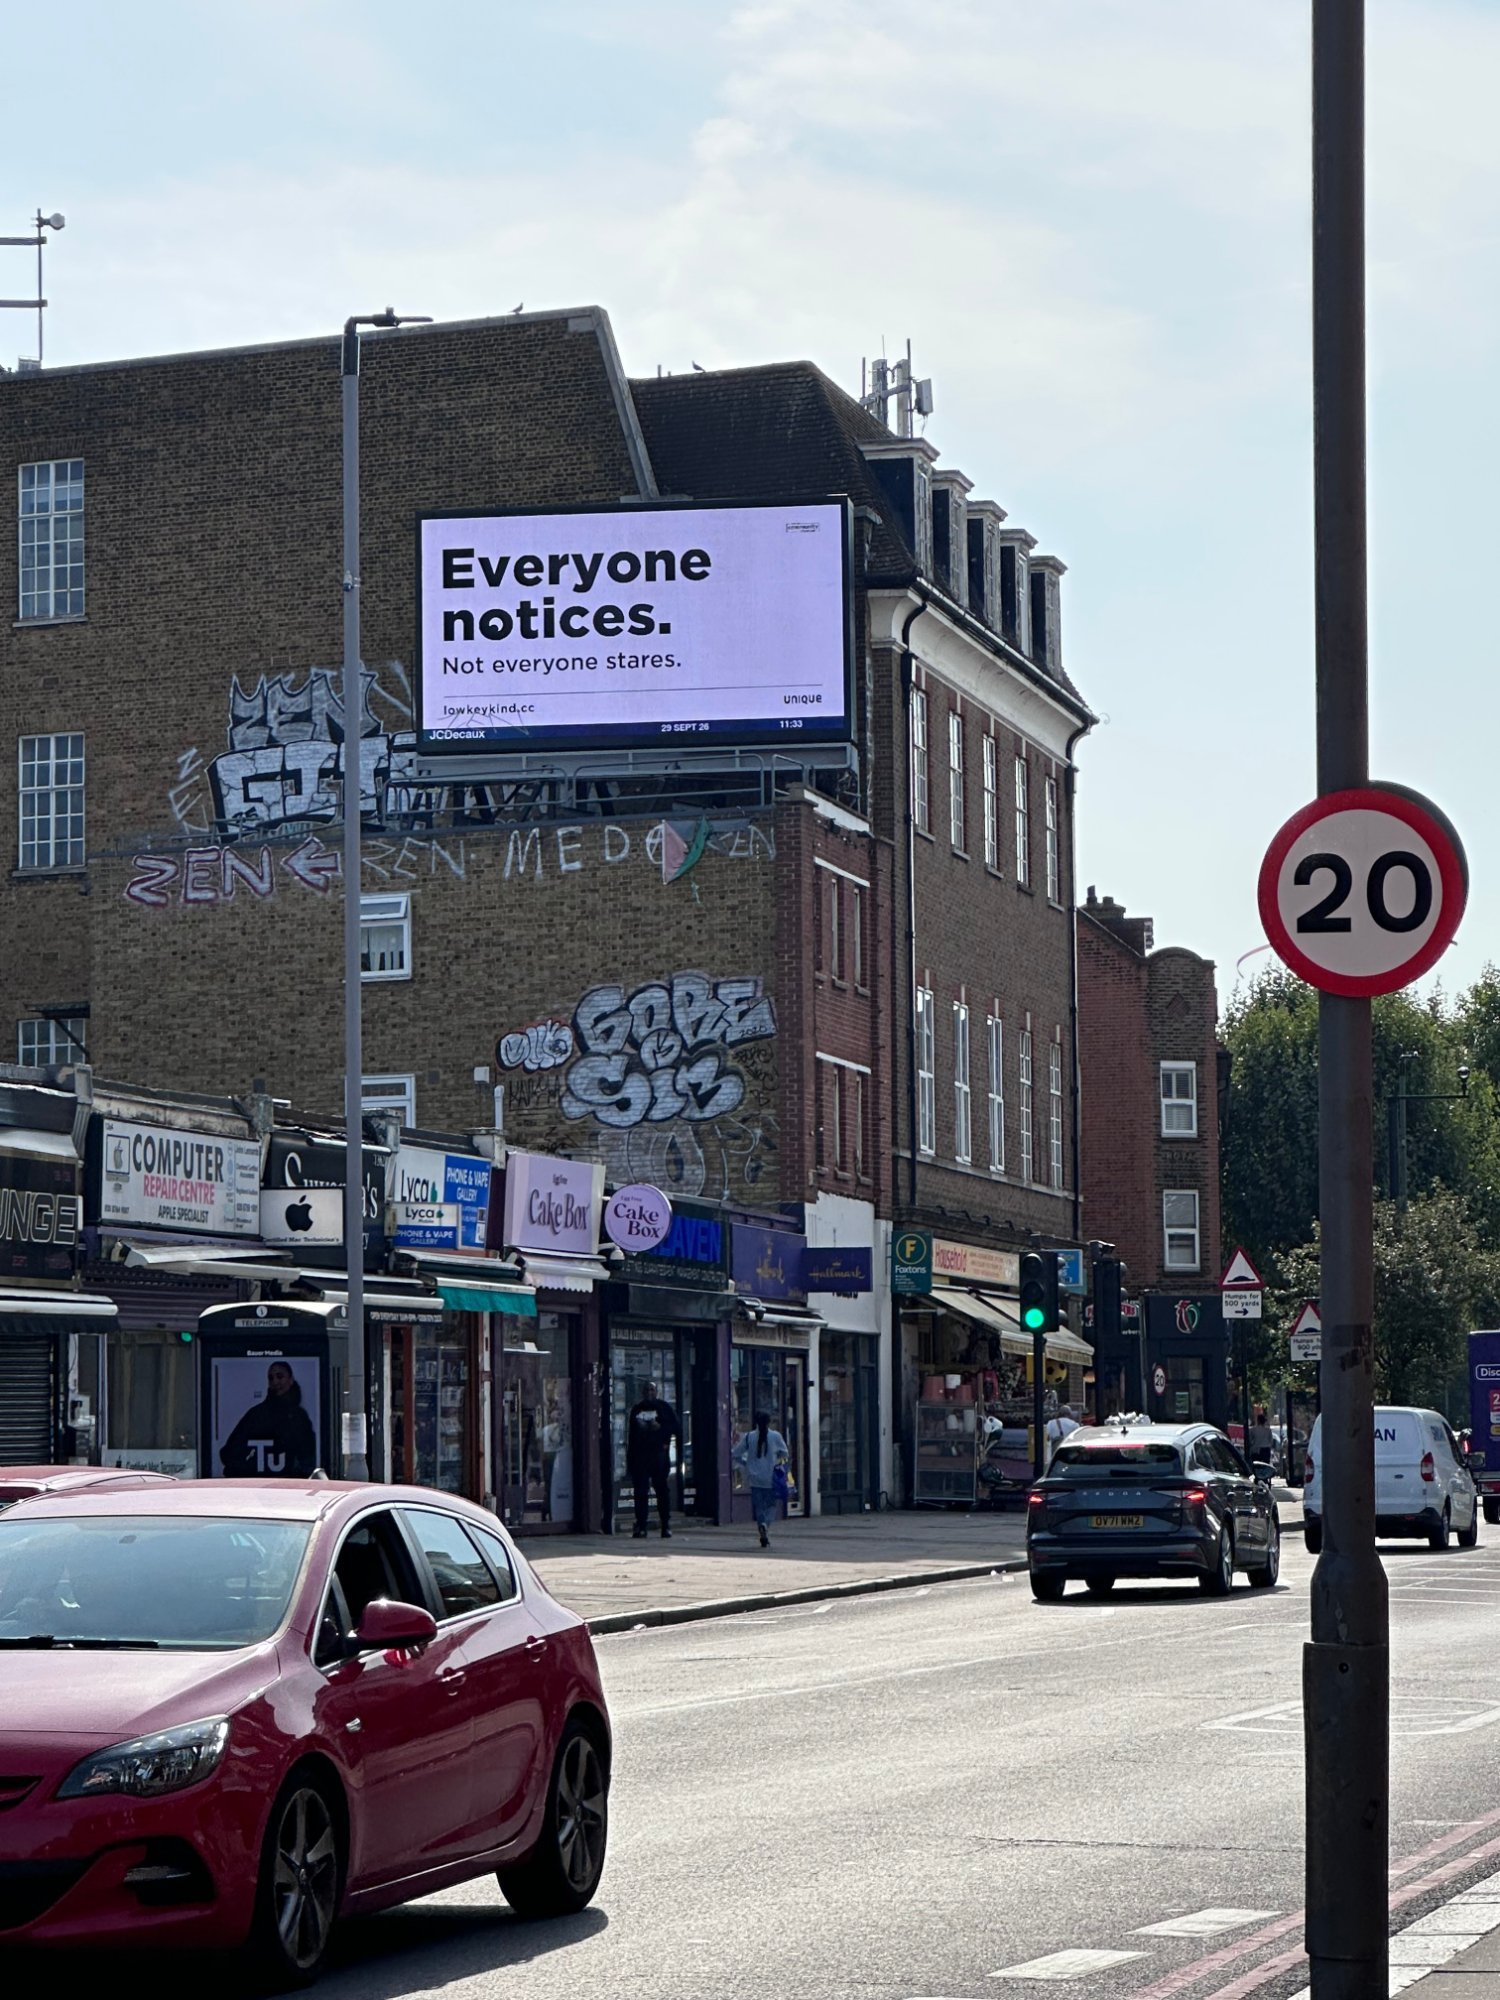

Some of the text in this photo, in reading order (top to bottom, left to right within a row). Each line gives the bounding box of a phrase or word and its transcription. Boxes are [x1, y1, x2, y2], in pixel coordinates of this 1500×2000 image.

[442, 547, 712, 593] Everyone
[443, 597, 671, 642] notices.
[443, 651, 682, 675] Not everyone stares.
[443, 703, 535, 716] lowkeykind.cc
[661, 724, 672, 732] 29
[673, 723, 696, 732] SEPT
[779, 719, 803, 729] 11:33
[429, 729, 486, 740] JCDecaux
[1293, 850, 1433, 934] 20
[132, 1133, 224, 1183] COMPUTER
[400, 1168, 430, 1202] Lyca
[446, 1167, 489, 1188] PHONE & VAPE
[143, 1174, 215, 1205] REPAIR CENTRE
[456, 1187, 478, 1202] GALLERY
[158, 1204, 209, 1224] APPLE SPECIALIST
[405, 1206, 435, 1220] Lyca
[529, 1188, 588, 1236] Cake Box
[613, 1202, 659, 1225] Cake
[425, 1231, 432, 1239] &
[433, 1230, 453, 1239] VAPE
[627, 1220, 660, 1239] Box
[808, 1265, 865, 1283] Hallmark
[895, 1264, 927, 1274] Foxtons
[1240, 1300, 1260, 1308] yards
[241, 1319, 284, 1327] TELEPHONE
[1155, 1373, 1165, 1386] 20
[248, 1439, 286, 1472] Tu
